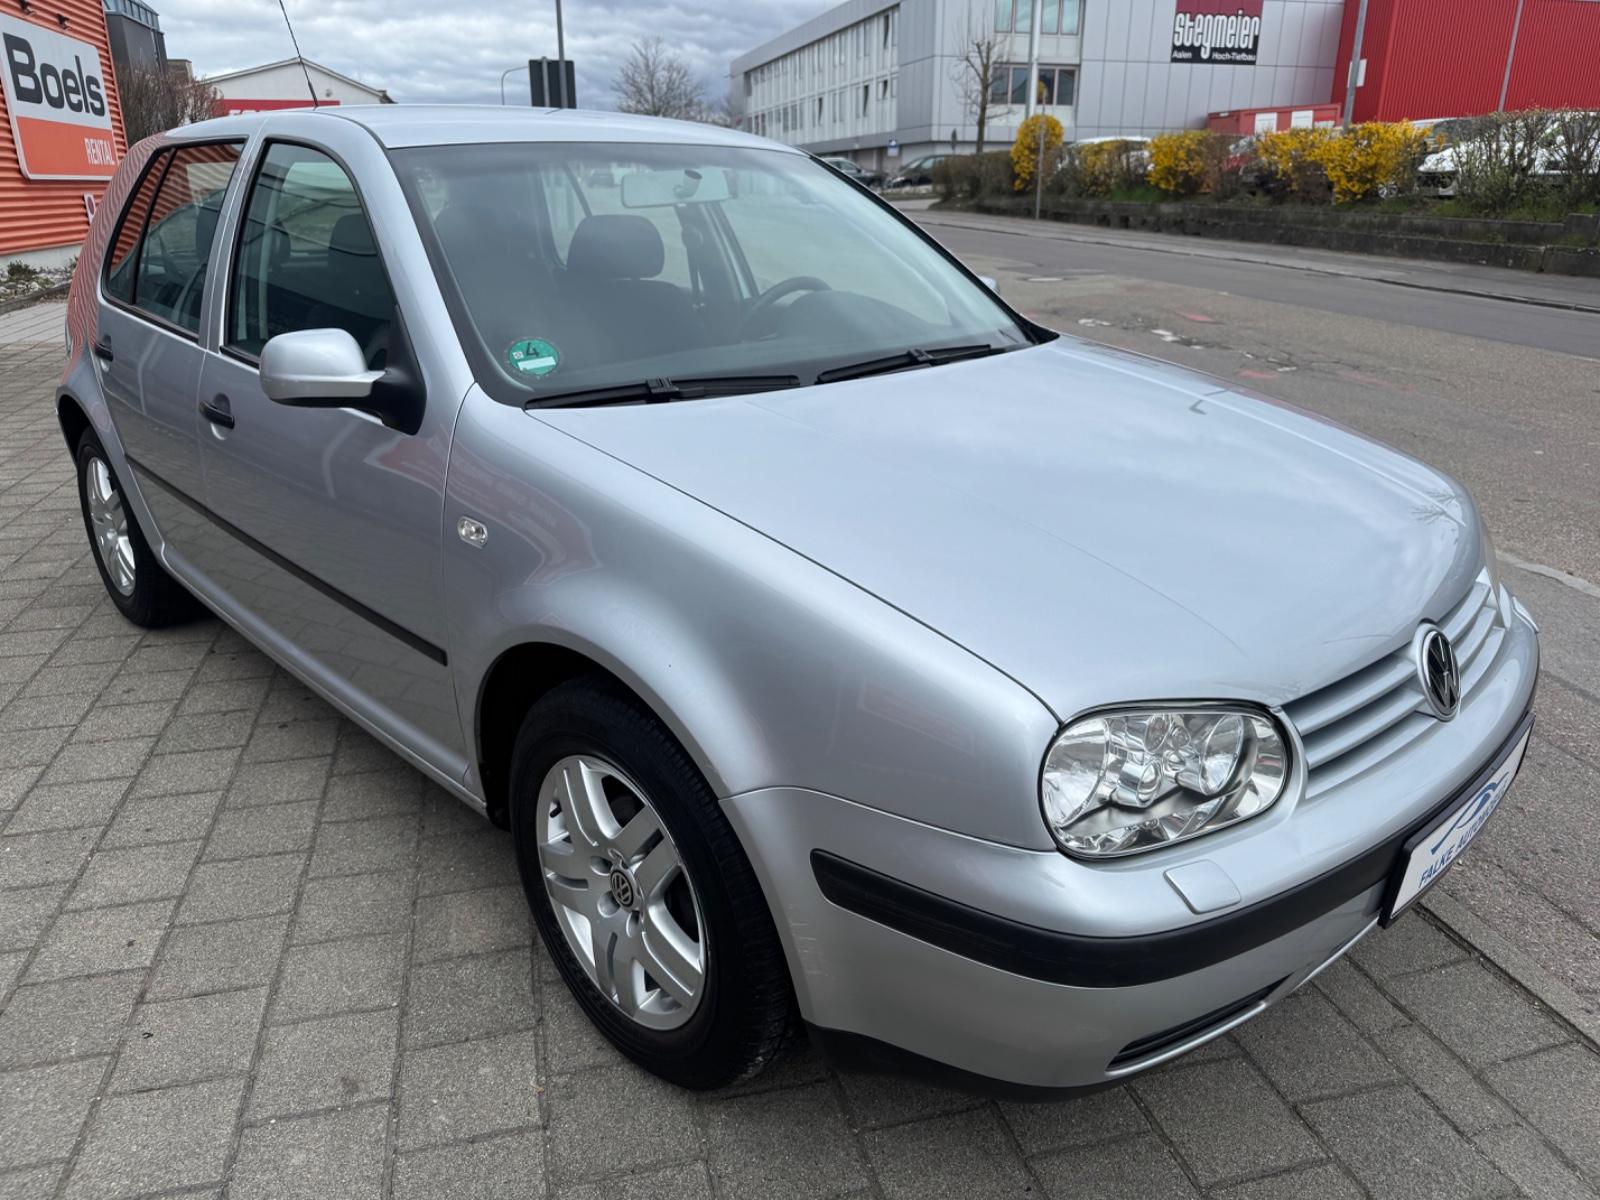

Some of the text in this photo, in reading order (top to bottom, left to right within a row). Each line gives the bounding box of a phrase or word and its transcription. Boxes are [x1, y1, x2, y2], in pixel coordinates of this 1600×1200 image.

[1172, 50, 1192, 59] Aalen
[3, 32, 105, 117] Boels
[84, 138, 116, 166] RENTAL
[526, 341, 539, 357] 4
[1418, 844, 1455, 889] FALKE
